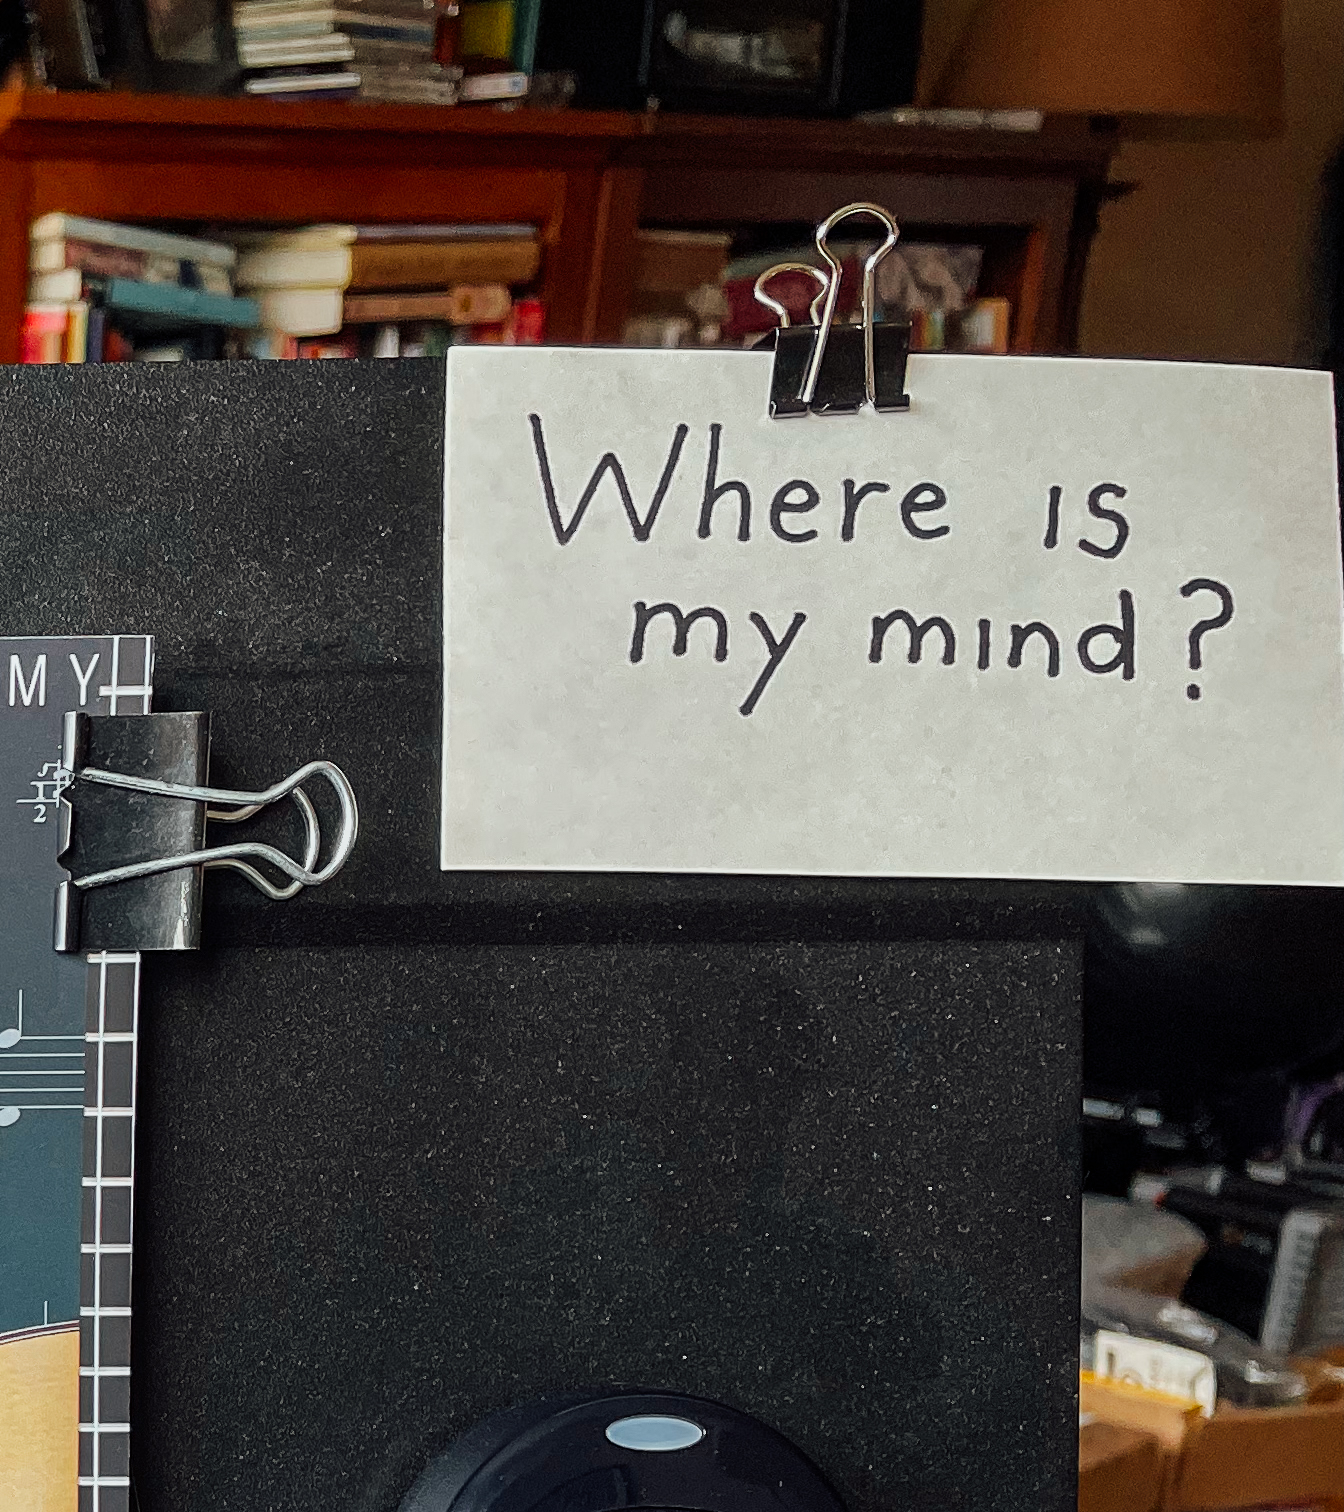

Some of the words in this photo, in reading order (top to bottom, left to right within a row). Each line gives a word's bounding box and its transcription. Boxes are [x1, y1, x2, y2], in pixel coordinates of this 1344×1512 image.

[530, 413, 951, 546] Where
[1043, 483, 1130, 559] is
[630, 600, 807, 717] my
[33, 804, 47, 823] 2
